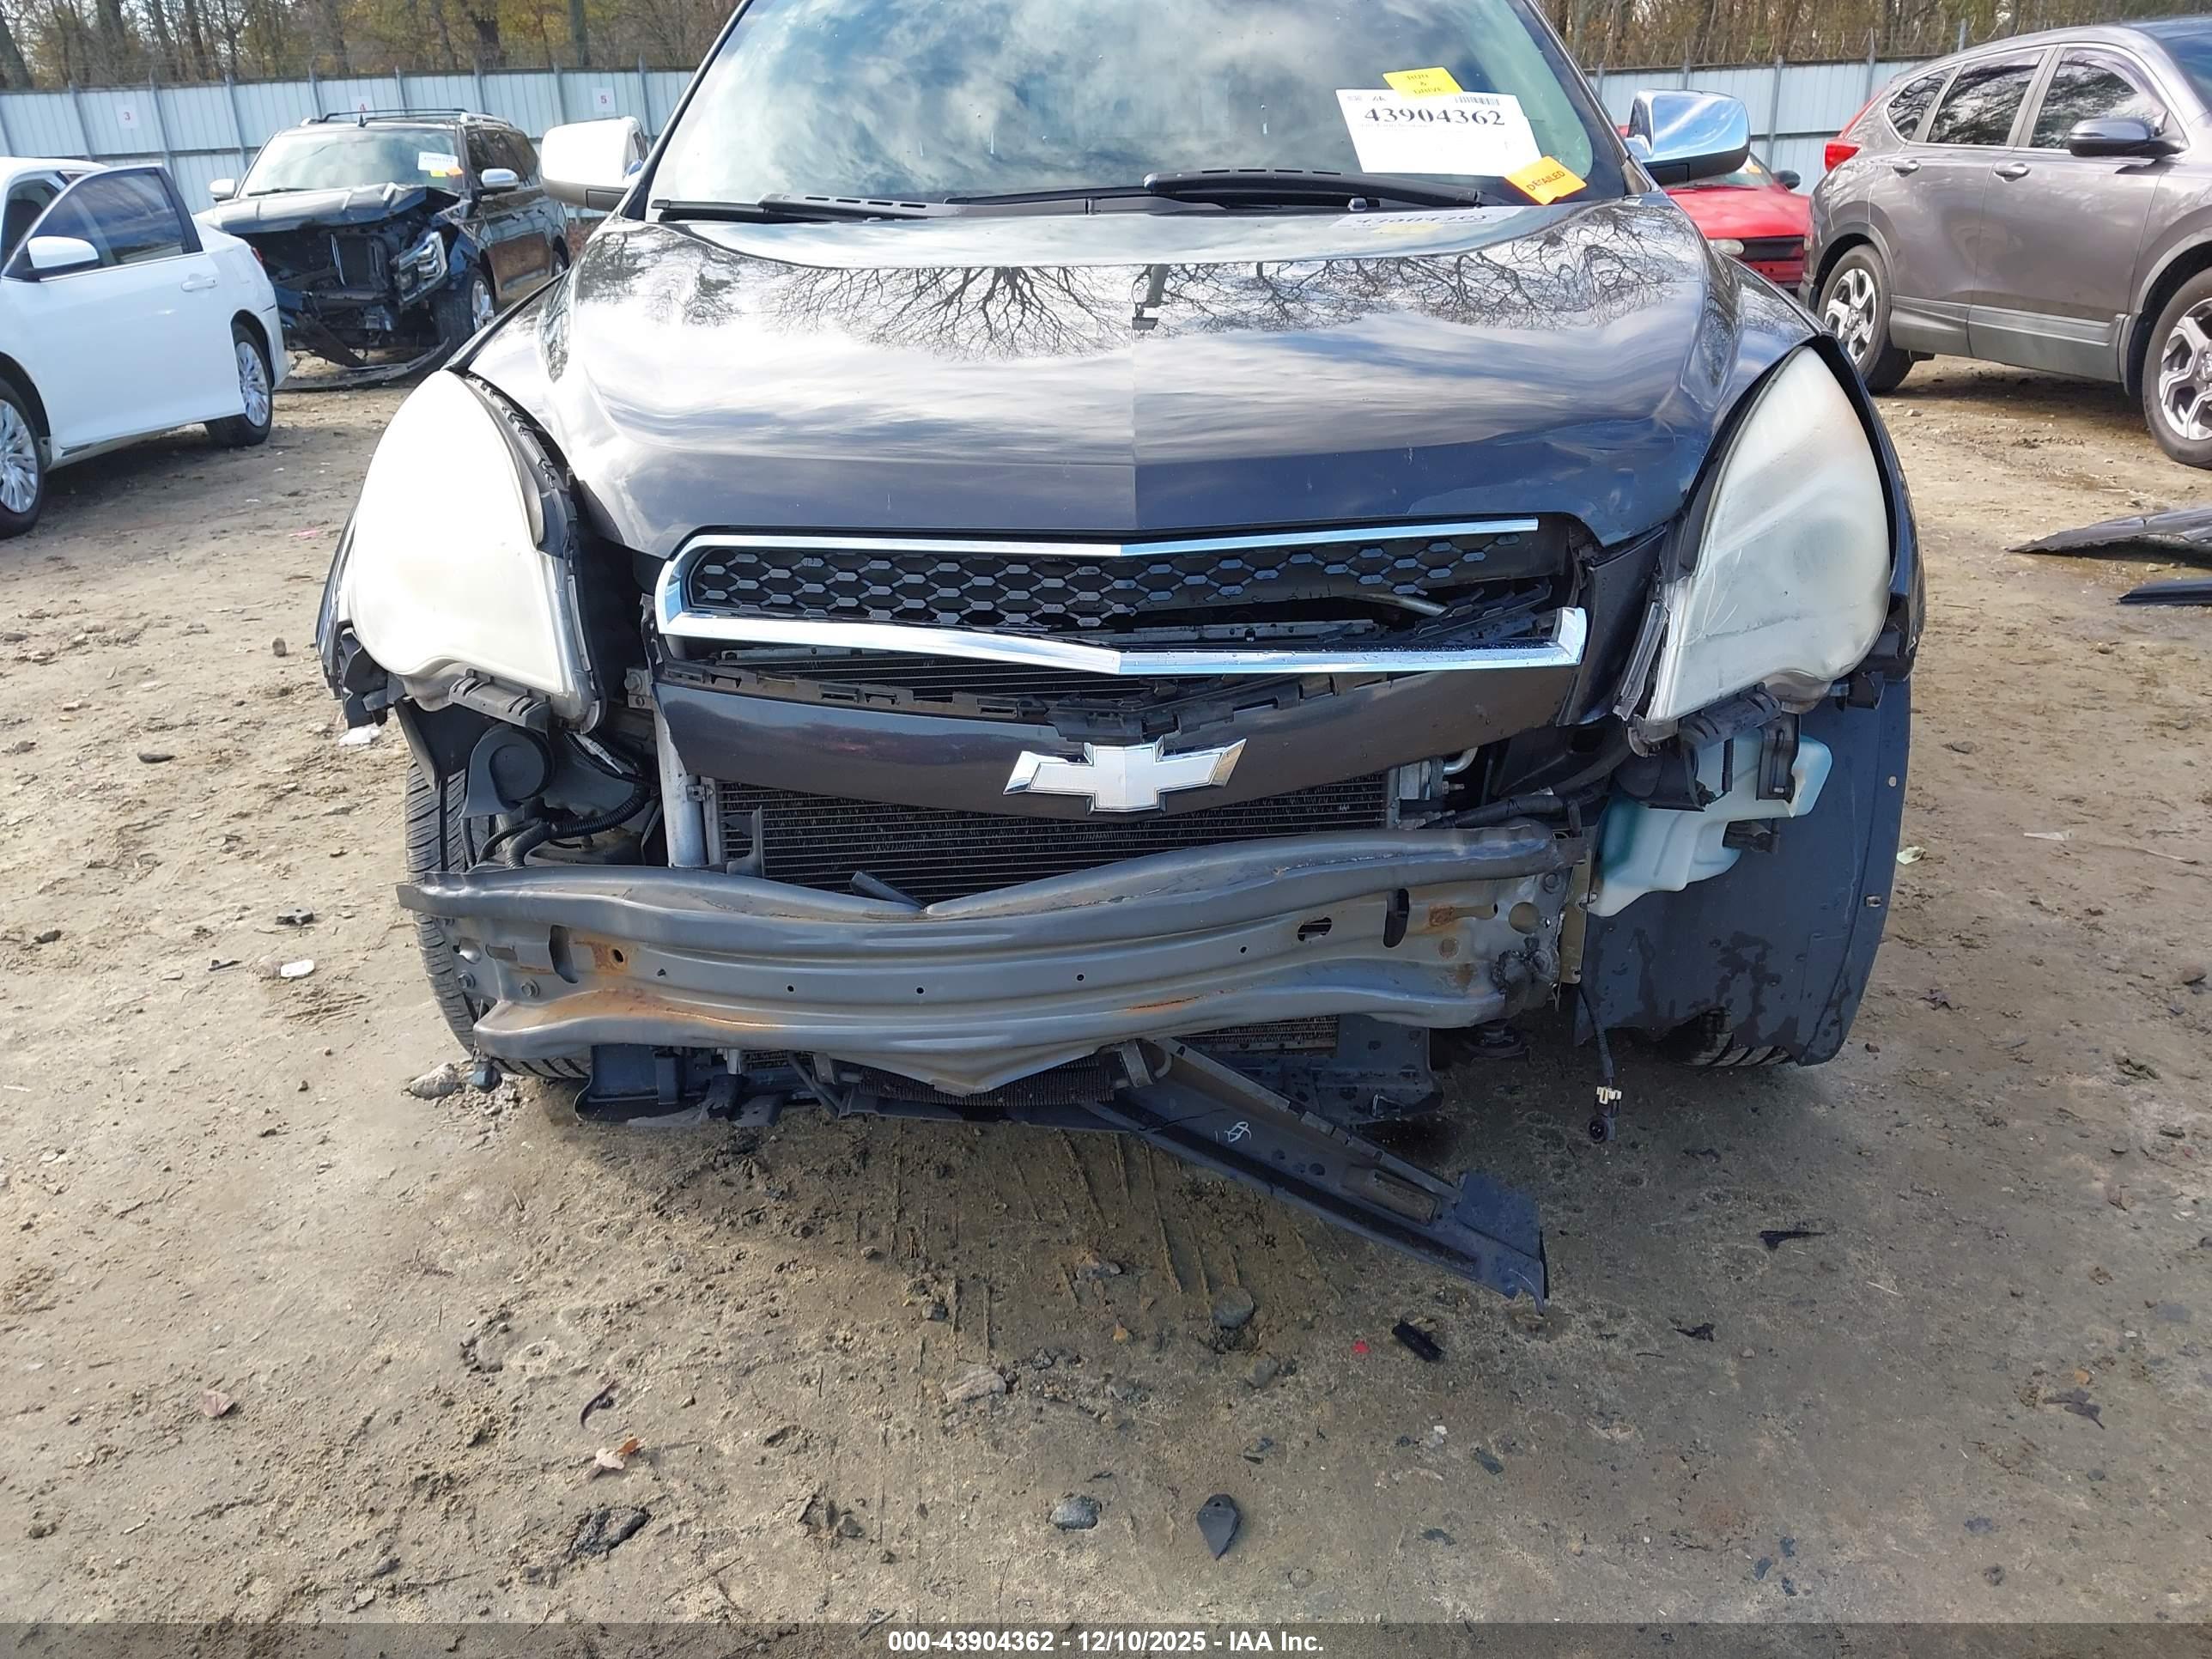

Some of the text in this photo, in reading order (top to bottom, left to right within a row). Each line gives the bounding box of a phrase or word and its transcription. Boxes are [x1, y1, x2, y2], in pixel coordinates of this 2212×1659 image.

[600, 95, 607, 104] 5
[123, 112, 131, 121] 3
[1364, 107, 1505, 125] 43904362
[1526, 170, 1566, 191] DETAILED
